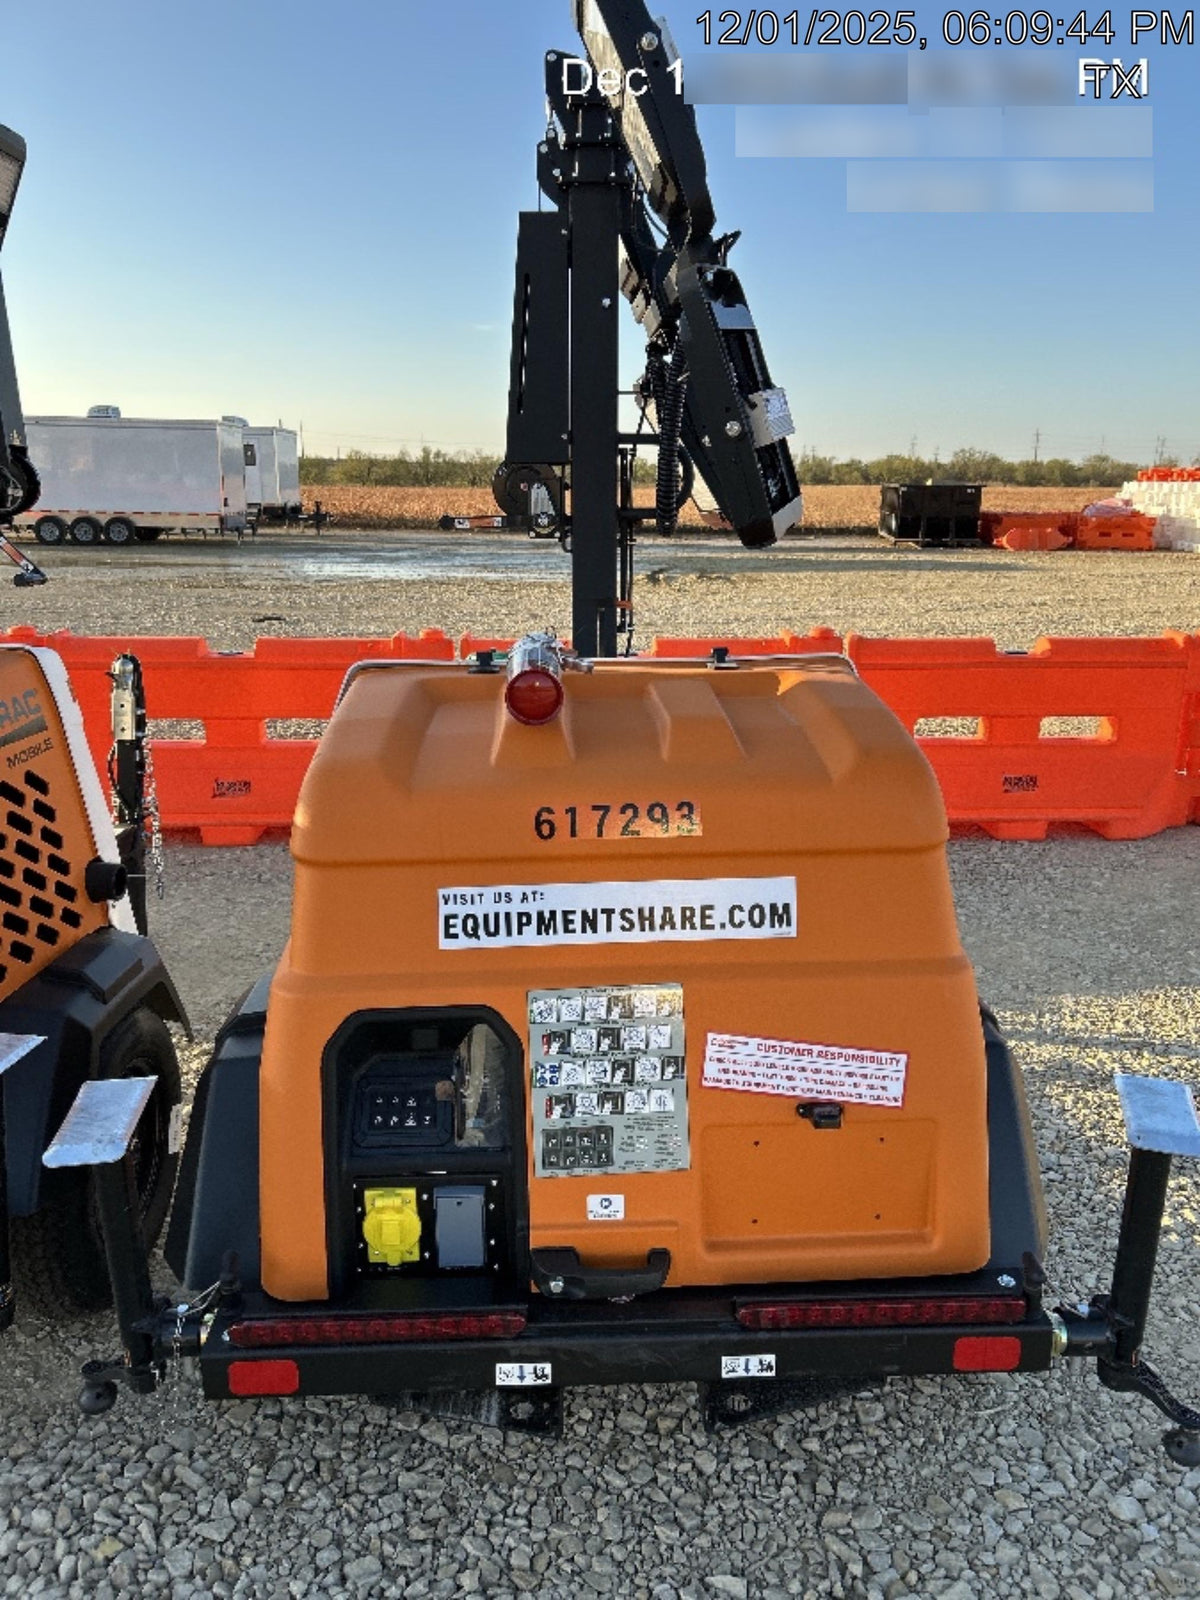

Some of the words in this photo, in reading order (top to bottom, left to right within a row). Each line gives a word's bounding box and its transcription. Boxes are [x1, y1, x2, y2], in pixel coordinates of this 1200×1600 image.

[6, 737, 54, 769] MOBILE
[533, 800, 698, 840] 617293
[442, 893, 484, 905] VISIT
[493, 892, 513, 904] US
[520, 890, 545, 903] AT:
[443, 903, 793, 942] EQUIPMENTSHARE.COM
[756, 1043, 814, 1058] CUSTOMER
[816, 1050, 902, 1067] RESPONSIBILITY
